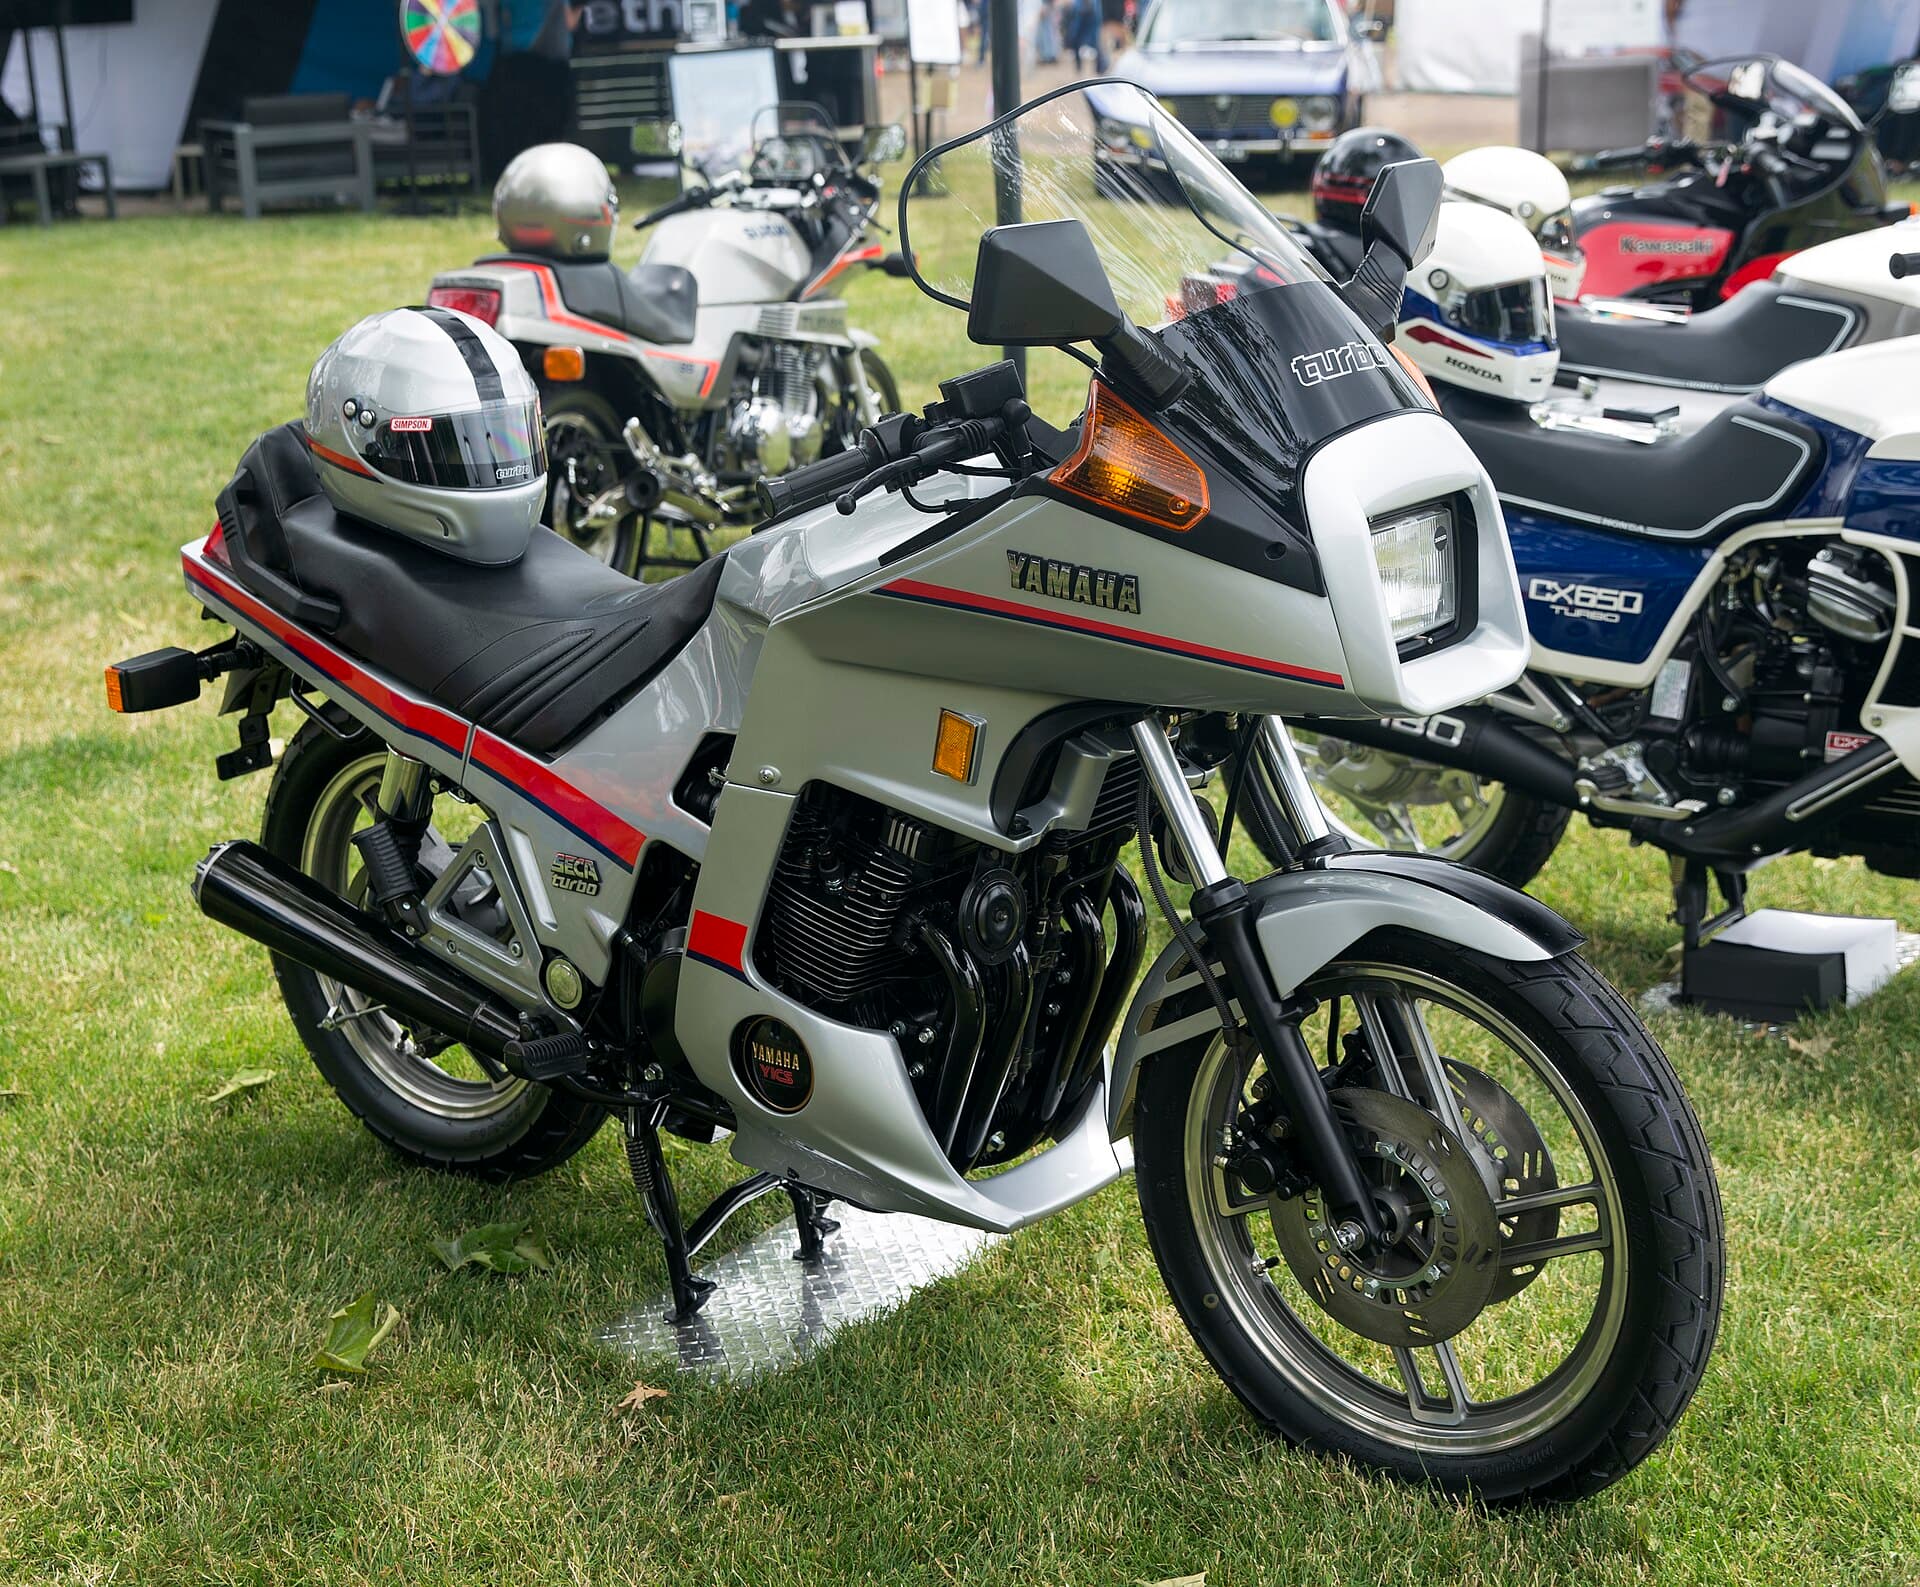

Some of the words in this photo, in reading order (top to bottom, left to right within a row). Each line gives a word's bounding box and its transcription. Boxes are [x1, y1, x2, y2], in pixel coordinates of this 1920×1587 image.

[1619, 235, 1715, 255] Kawasaki
[1290, 342, 1390, 387] turbo
[1445, 355, 1502, 383] HONDA
[393, 418, 428, 429] SIMPSON
[496, 464, 530, 480] turbo
[1006, 549, 1142, 615] YAMAHA
[1528, 578, 1643, 615] CX650
[1549, 604, 1621, 623] TURBO
[551, 852, 600, 883] SECA
[552, 873, 600, 896] turbo
[752, 1041, 800, 1071] YAMAHA
[760, 1063, 794, 1085] YICS
